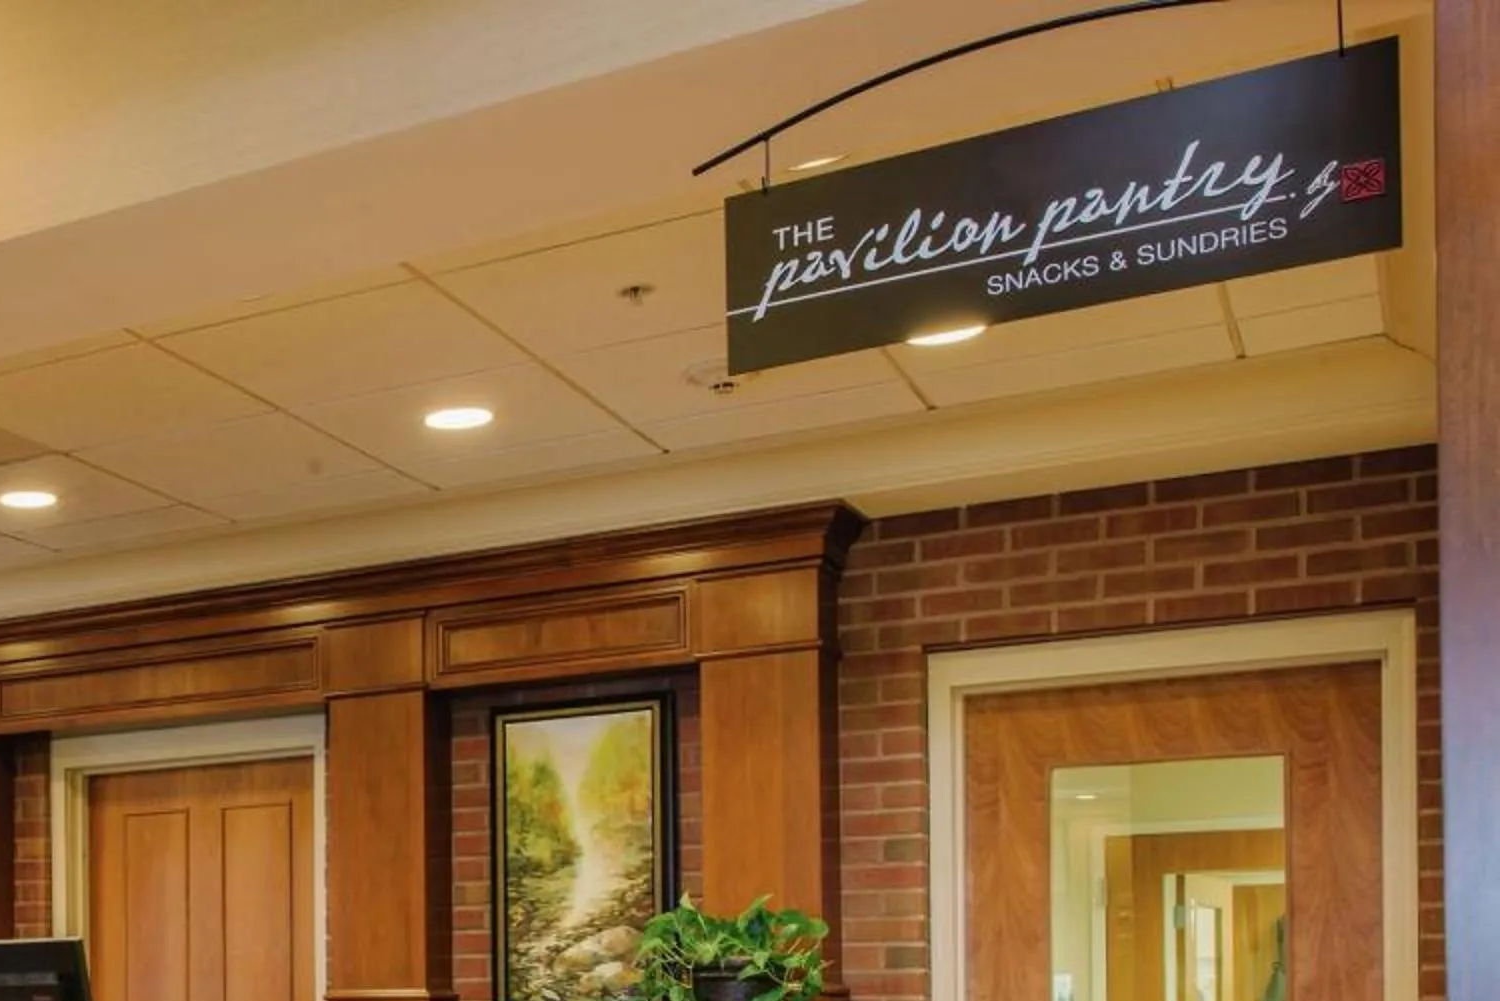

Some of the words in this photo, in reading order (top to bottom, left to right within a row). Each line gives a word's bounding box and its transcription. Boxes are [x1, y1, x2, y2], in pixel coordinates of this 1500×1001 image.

[752, 207, 1026, 322] pavilion
[772, 215, 835, 251] THE
[987, 256, 1100, 296] SNACKS
[1109, 250, 1129, 272] &
[1136, 217, 1288, 267] SUNDRIES
